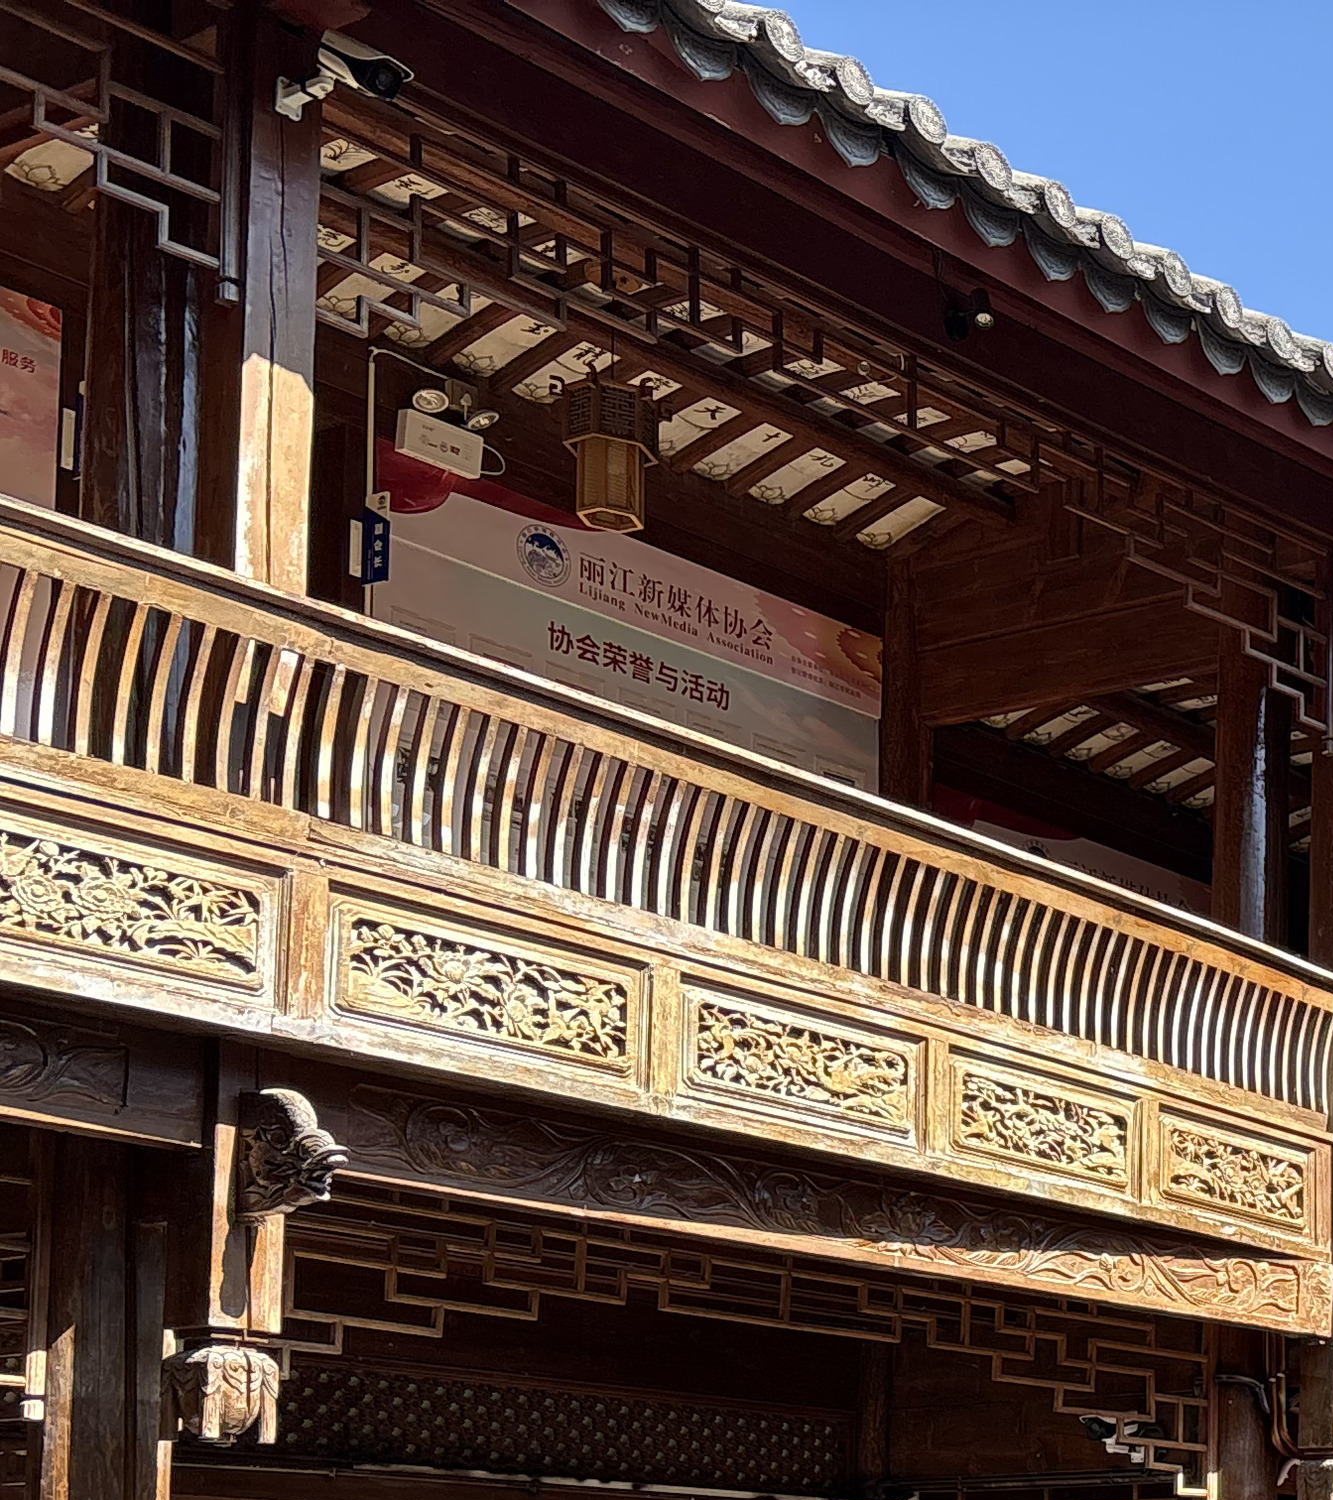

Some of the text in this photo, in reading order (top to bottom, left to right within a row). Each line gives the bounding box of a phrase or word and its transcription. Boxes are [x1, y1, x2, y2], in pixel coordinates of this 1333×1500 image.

[2, 348, 37, 374] 服务
[579, 581, 774, 665] Lijiang NewMedia Association
[580, 553, 774, 651] 丽江新媒体协会
[547, 621, 731, 712] 协会荣誉与活动
